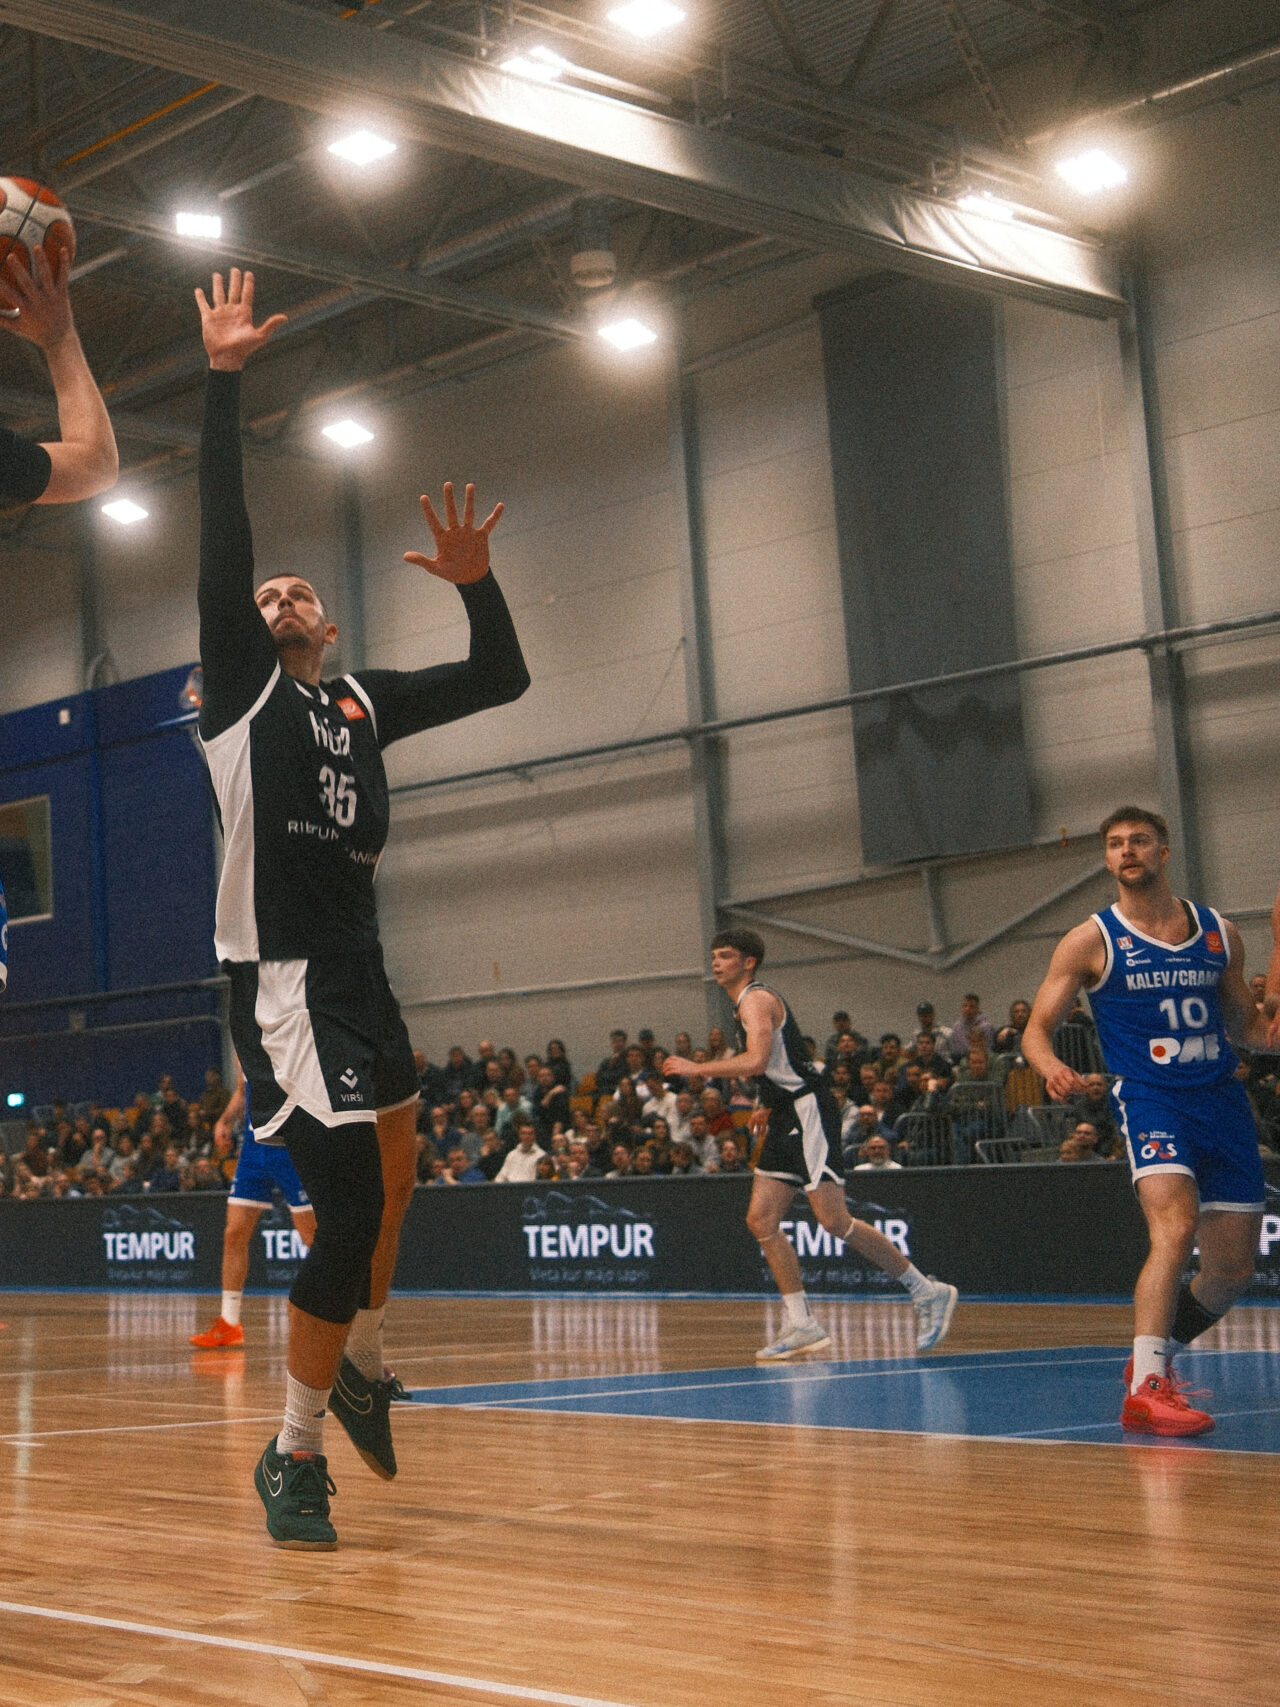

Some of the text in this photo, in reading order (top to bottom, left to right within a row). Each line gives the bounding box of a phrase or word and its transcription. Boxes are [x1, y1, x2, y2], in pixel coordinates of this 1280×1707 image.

[319, 765, 358, 827] 35
[1159, 997, 1210, 1031] 10
[103, 1230, 195, 1260] TEMPUR
[261, 1228, 310, 1260] TEM
[523, 1223, 655, 1258] TEMPUR
